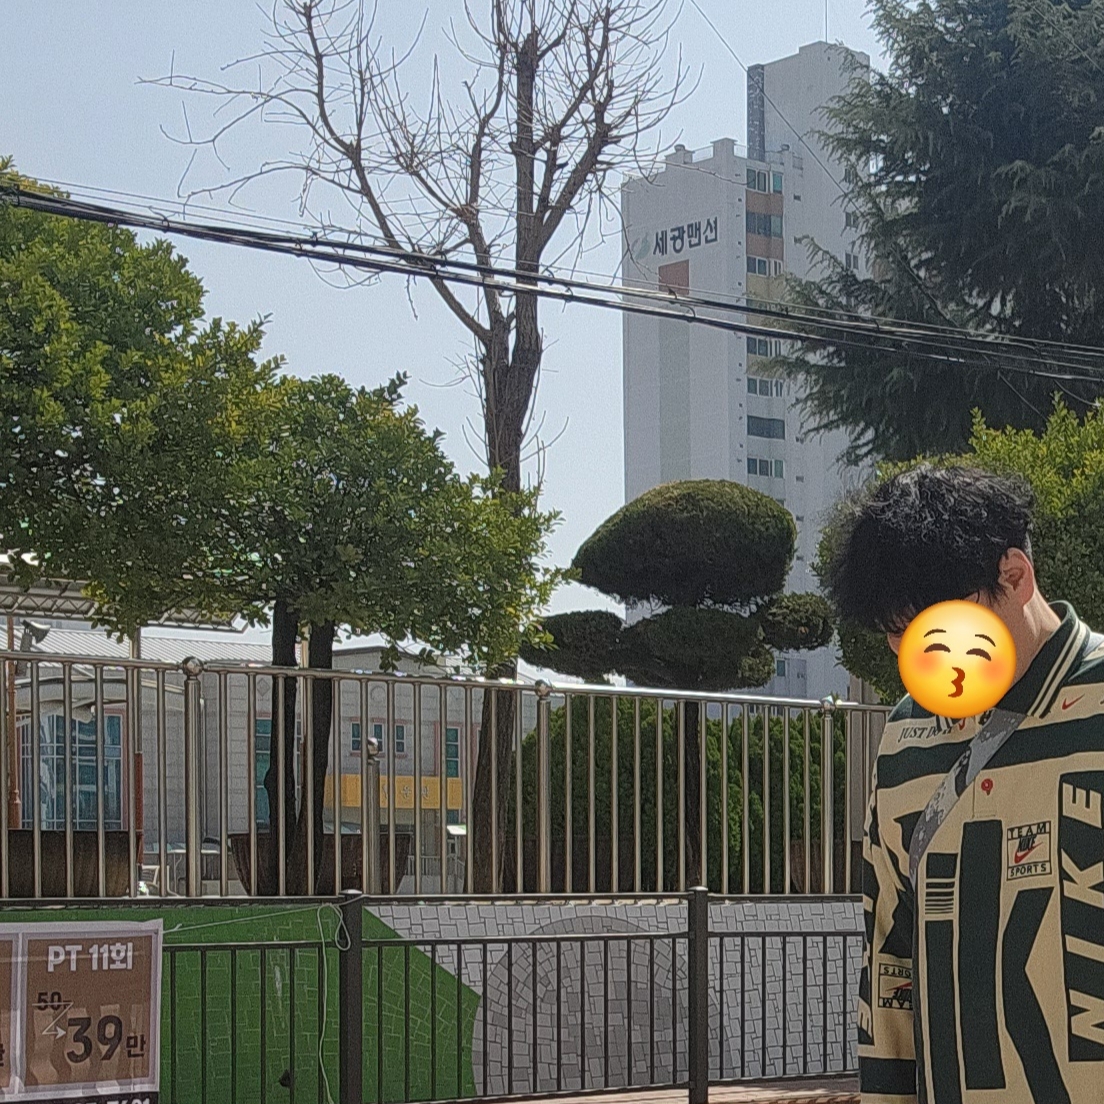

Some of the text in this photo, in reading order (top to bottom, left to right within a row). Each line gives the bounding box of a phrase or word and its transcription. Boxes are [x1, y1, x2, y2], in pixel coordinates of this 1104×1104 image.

[653, 217, 718, 256] 세광맨션
[898, 727, 928, 743] JUST
[1008, 821, 1047, 839] TEAM
[1010, 863, 1047, 877] SPORTS
[47, 942, 133, 972] PT 11회
[883, 966, 911, 978] ORTS
